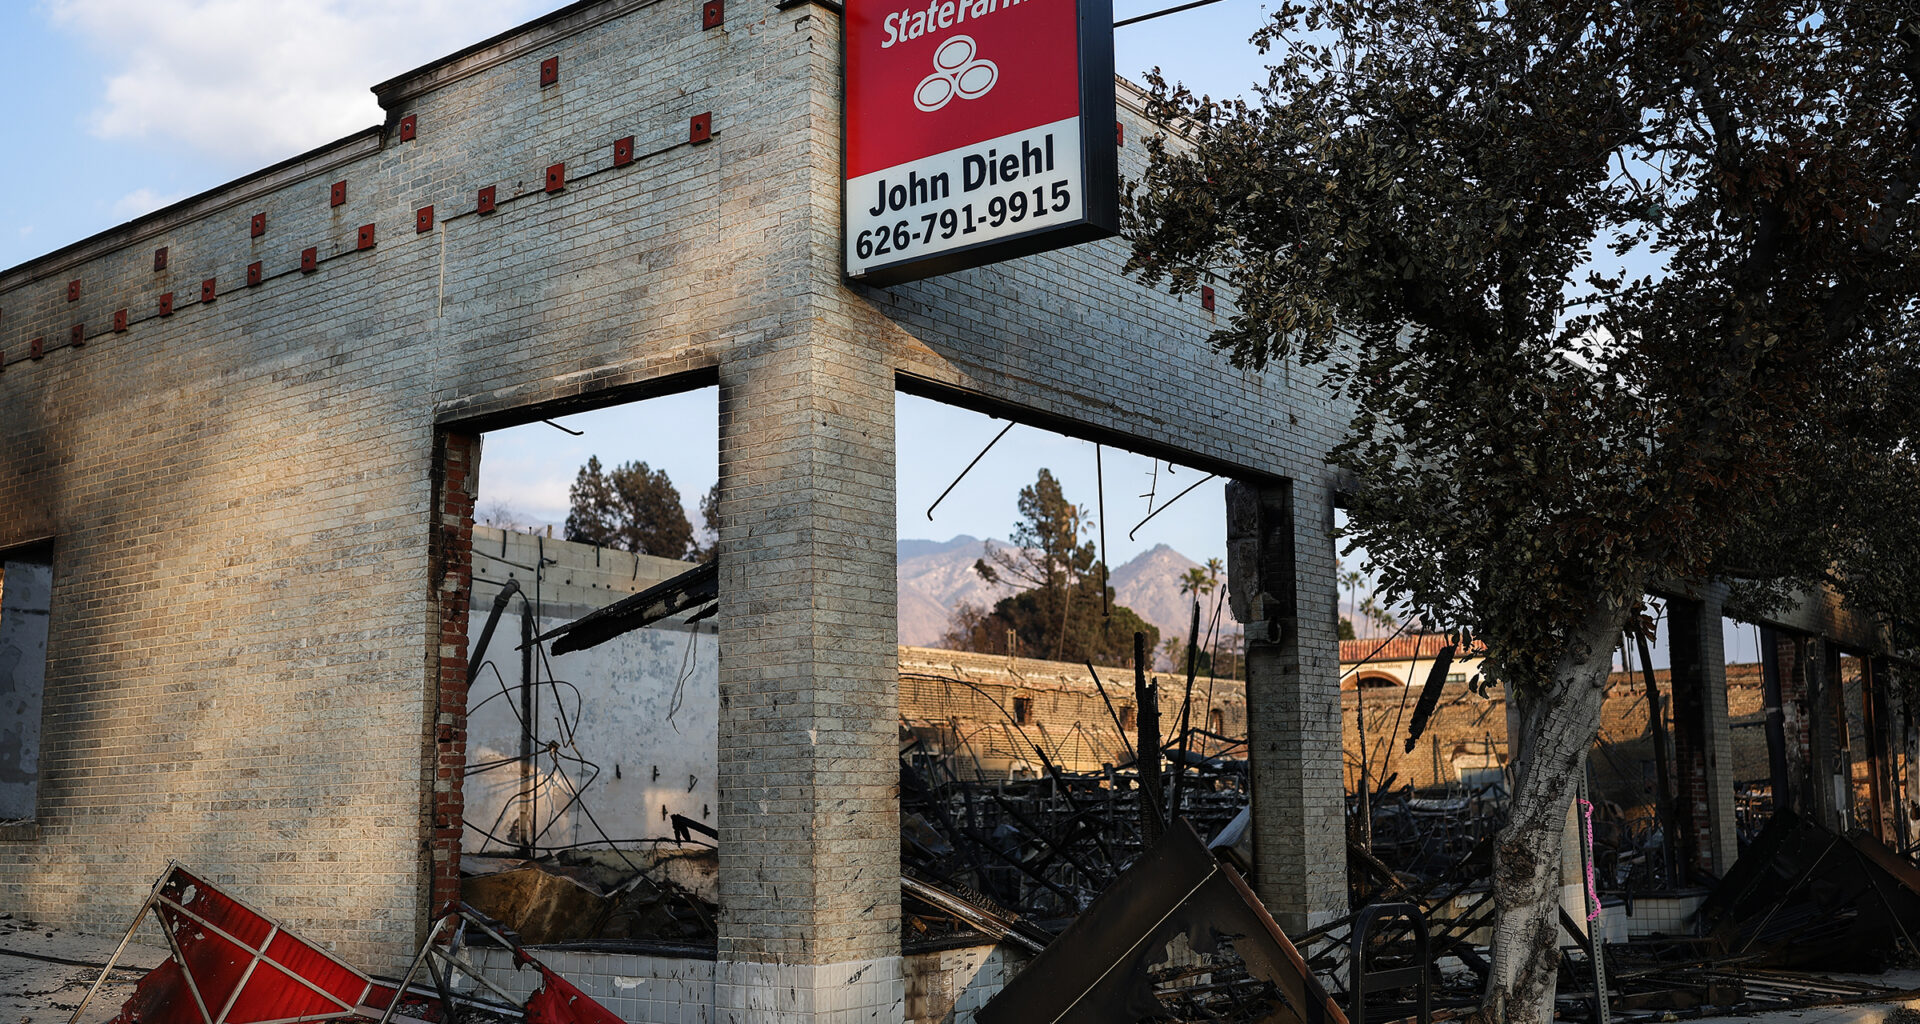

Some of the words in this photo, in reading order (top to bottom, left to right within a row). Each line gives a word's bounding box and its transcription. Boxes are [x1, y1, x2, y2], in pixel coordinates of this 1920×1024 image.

[869, 171, 950, 217] John
[963, 134, 1055, 193] Diehl
[856, 179, 1071, 260] 626-791-9915
